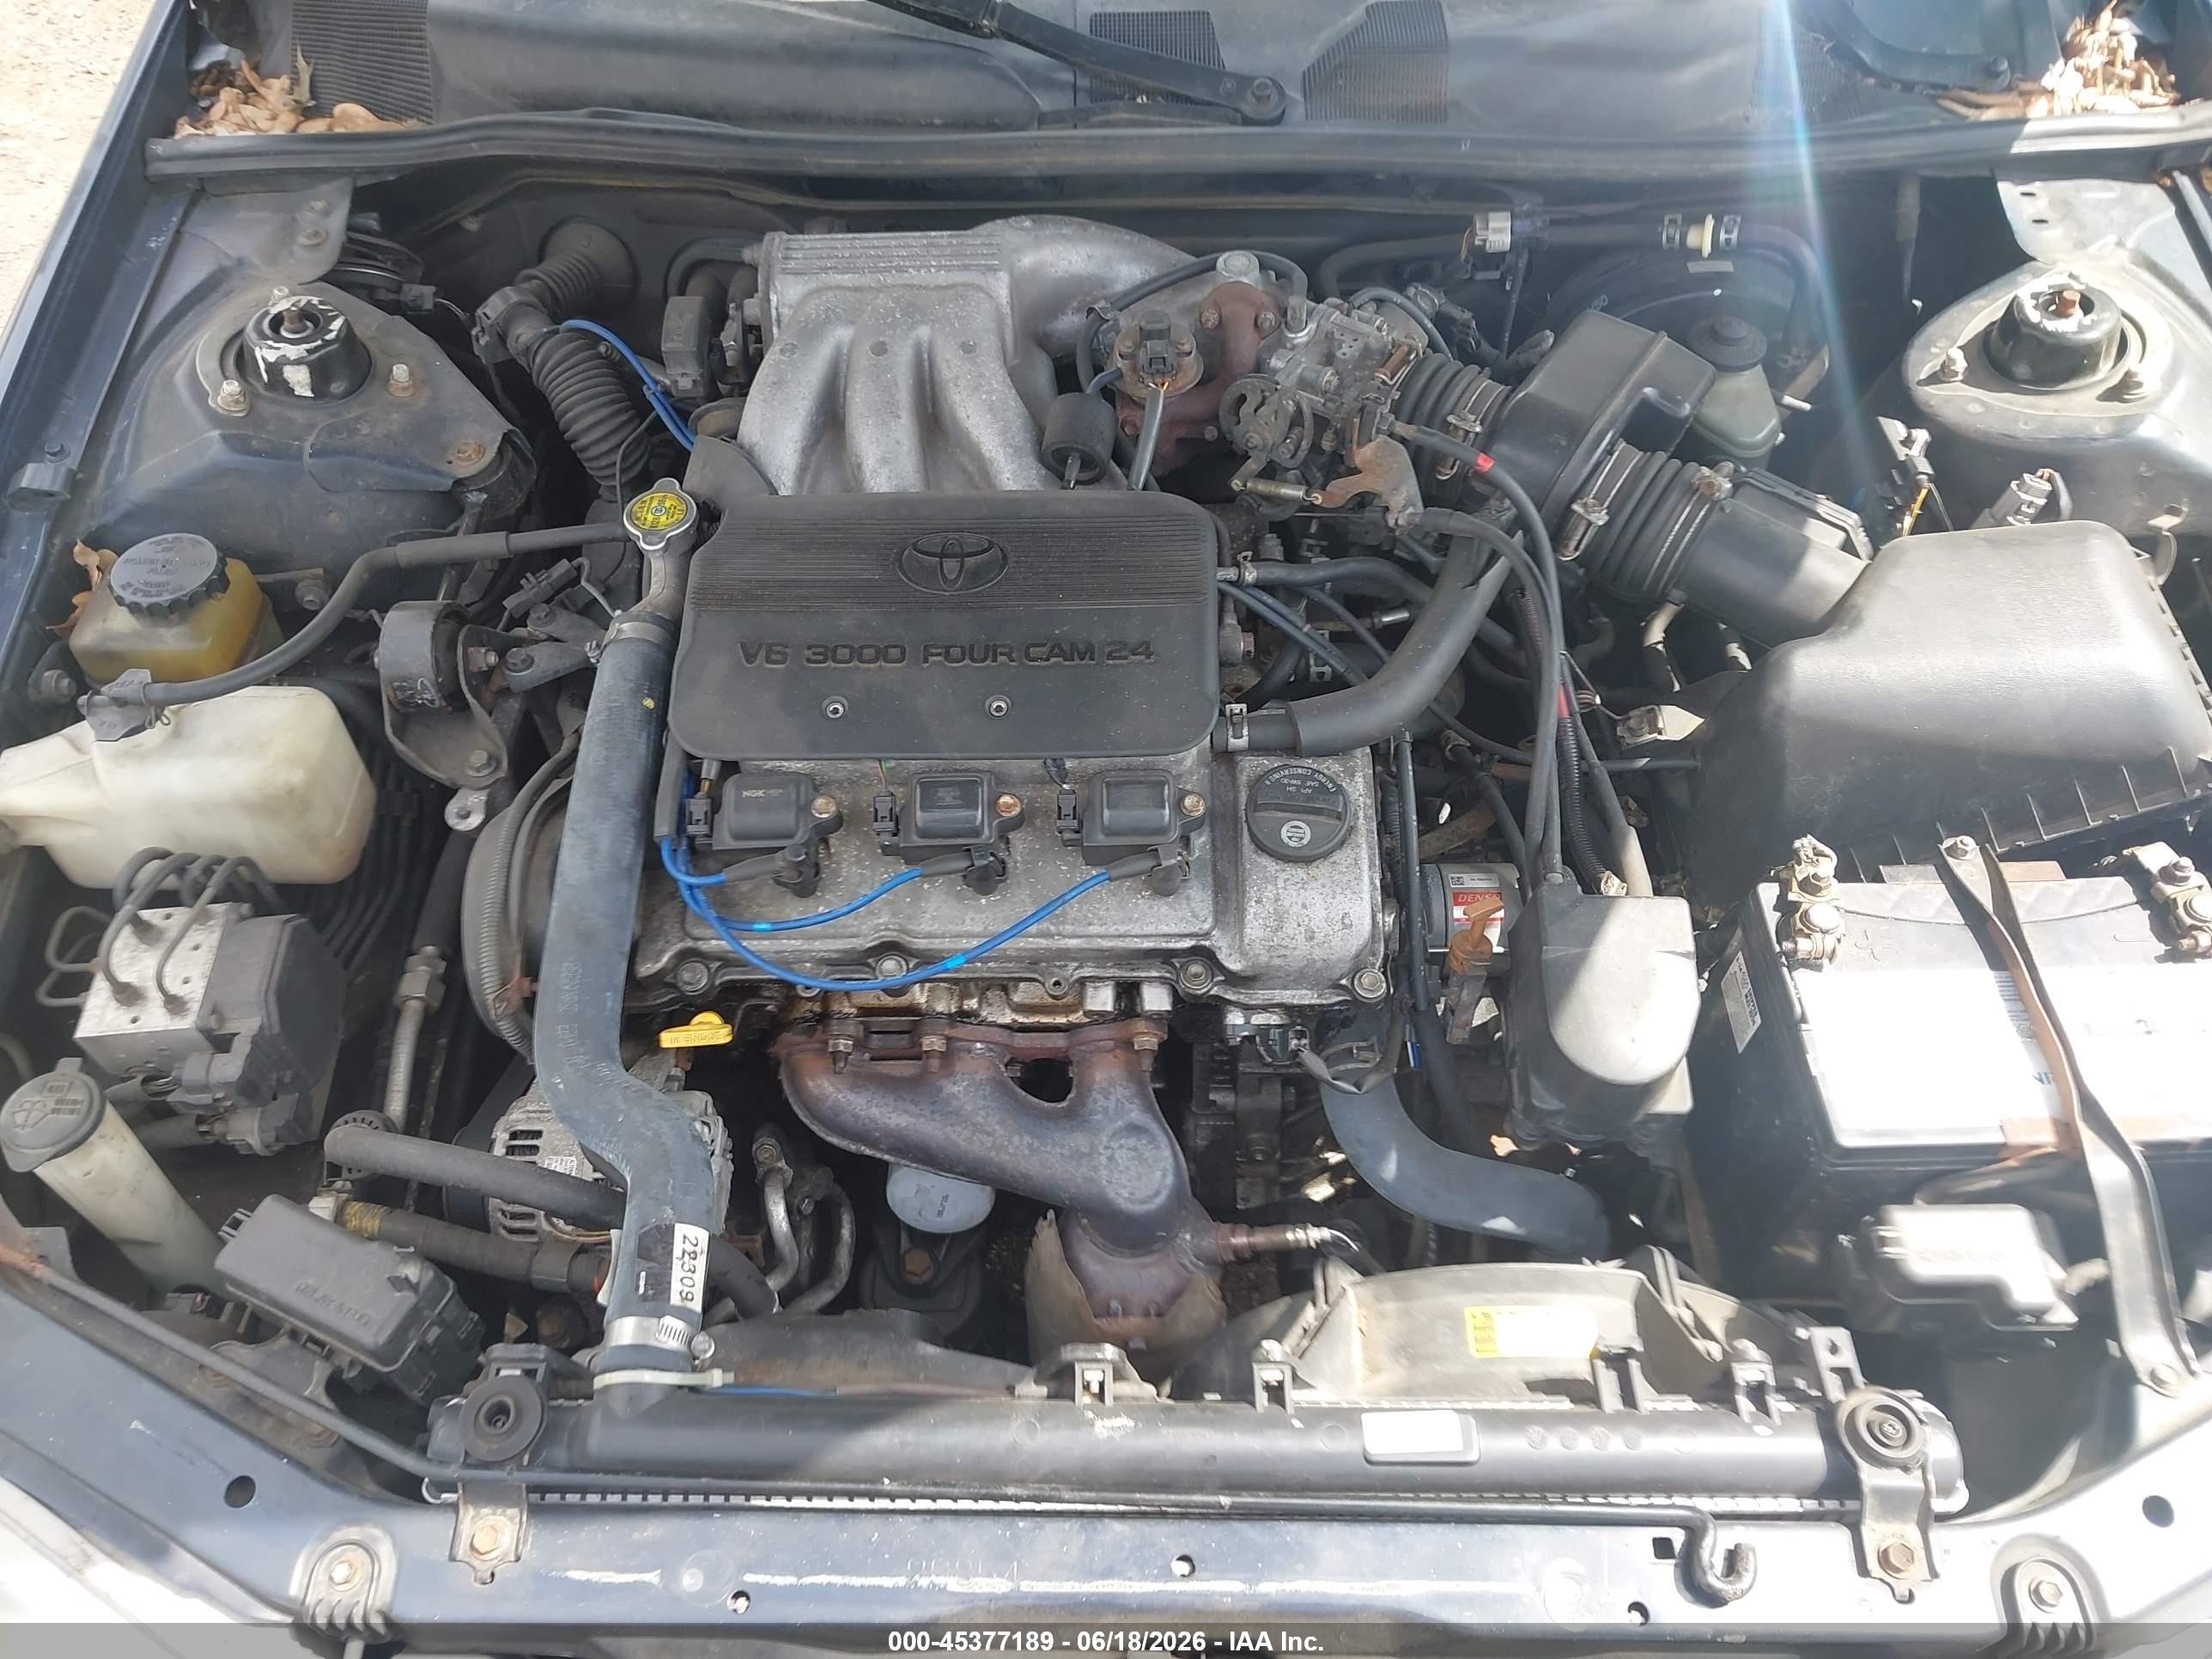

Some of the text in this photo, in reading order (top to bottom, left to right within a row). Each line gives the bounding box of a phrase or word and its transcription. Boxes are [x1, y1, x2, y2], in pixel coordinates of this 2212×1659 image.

[739, 641, 1154, 666] V6 3000 FOUR CAM 24
[1269, 768, 1312, 781] CONSERVING
[1314, 772, 1337, 793] ENERGY
[742, 789, 766, 798] NGK
